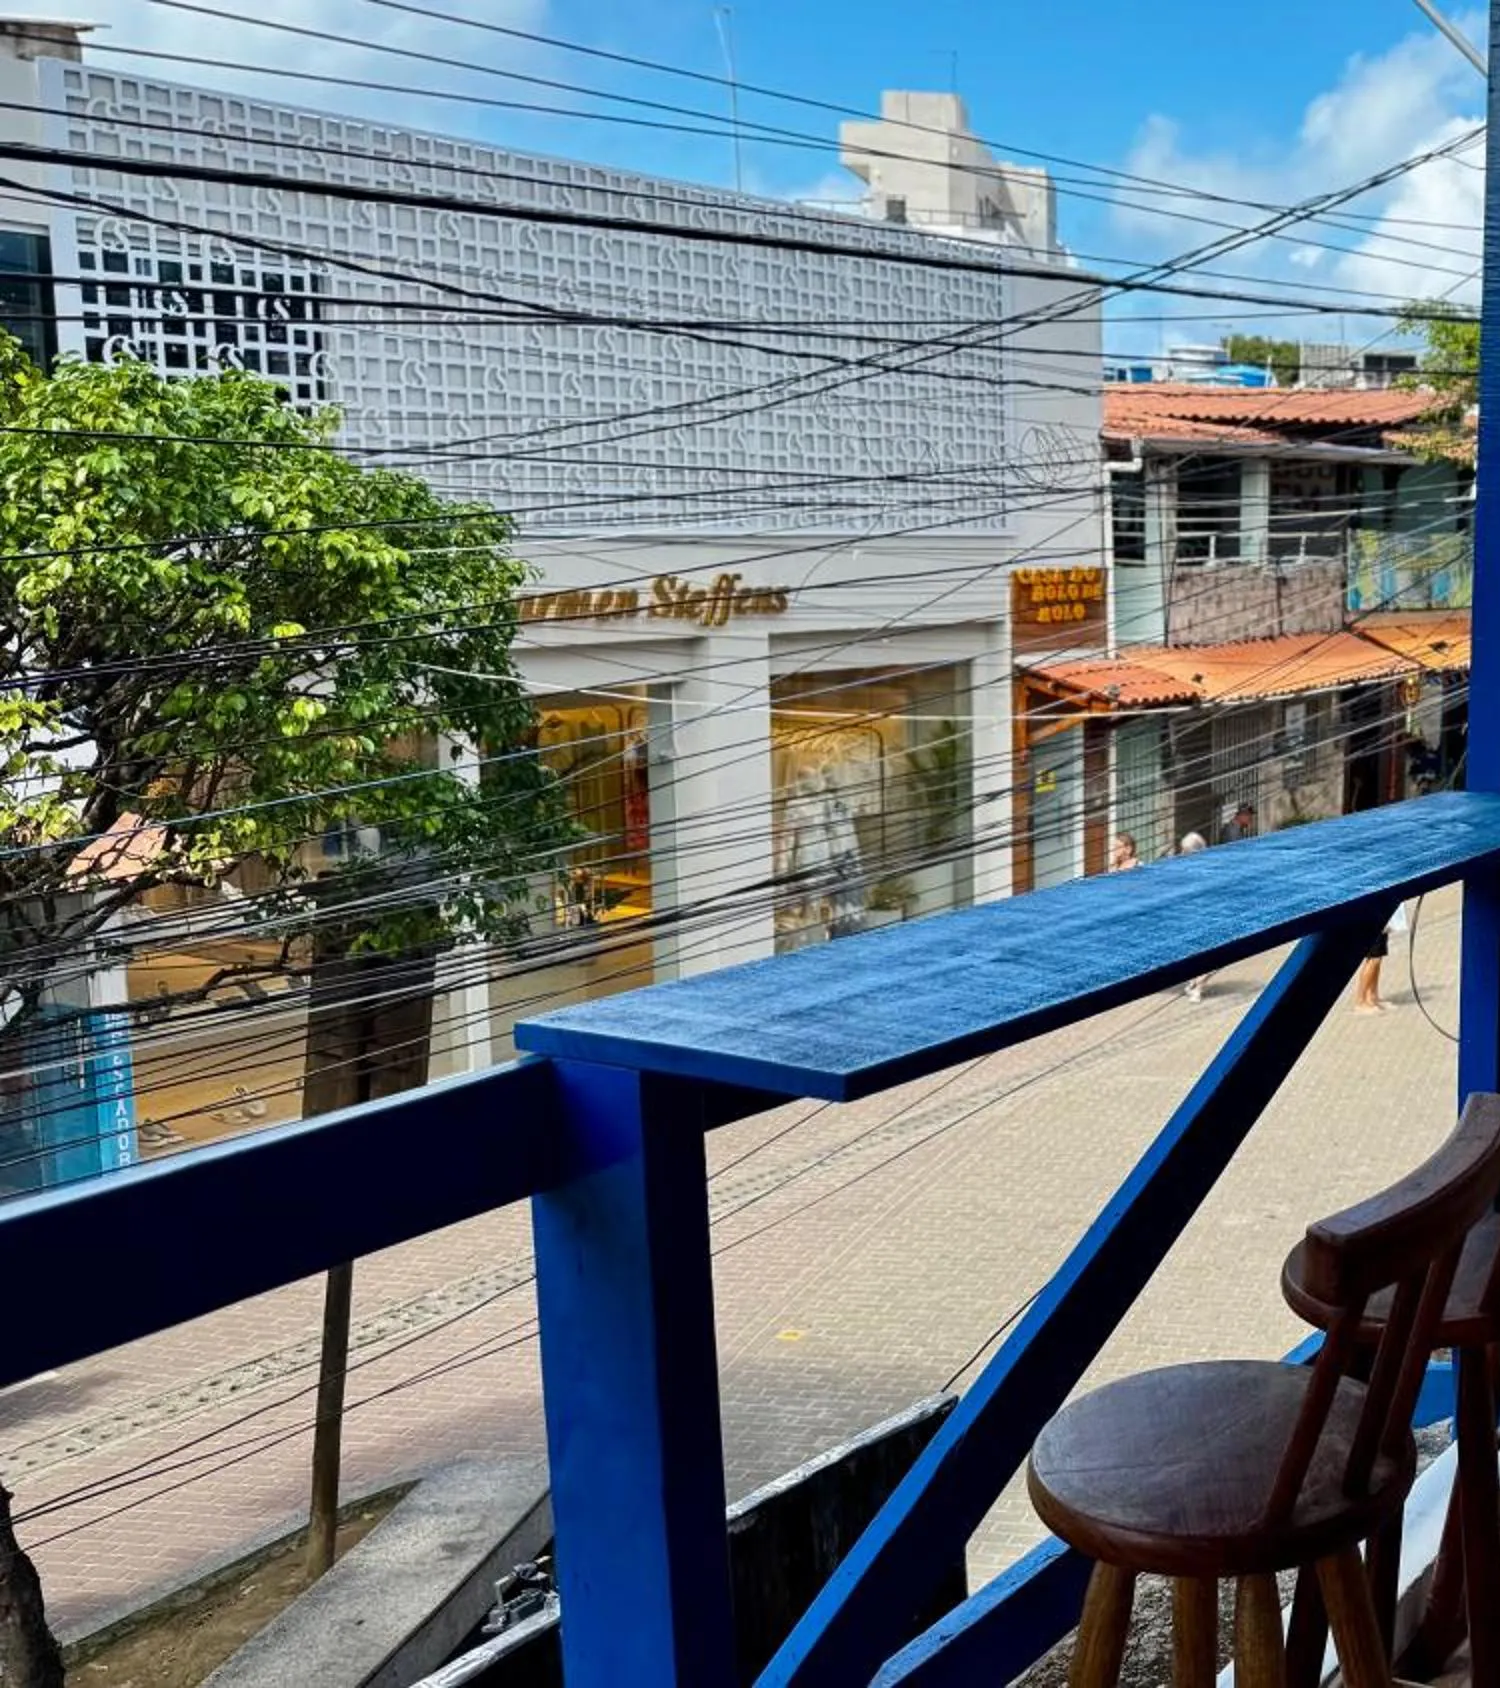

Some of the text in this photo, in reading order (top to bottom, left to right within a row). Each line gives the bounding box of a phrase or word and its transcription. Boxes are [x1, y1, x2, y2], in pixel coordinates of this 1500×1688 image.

[515, 573, 788, 626] armen Steffens
[1032, 583, 1080, 602] BOLO
